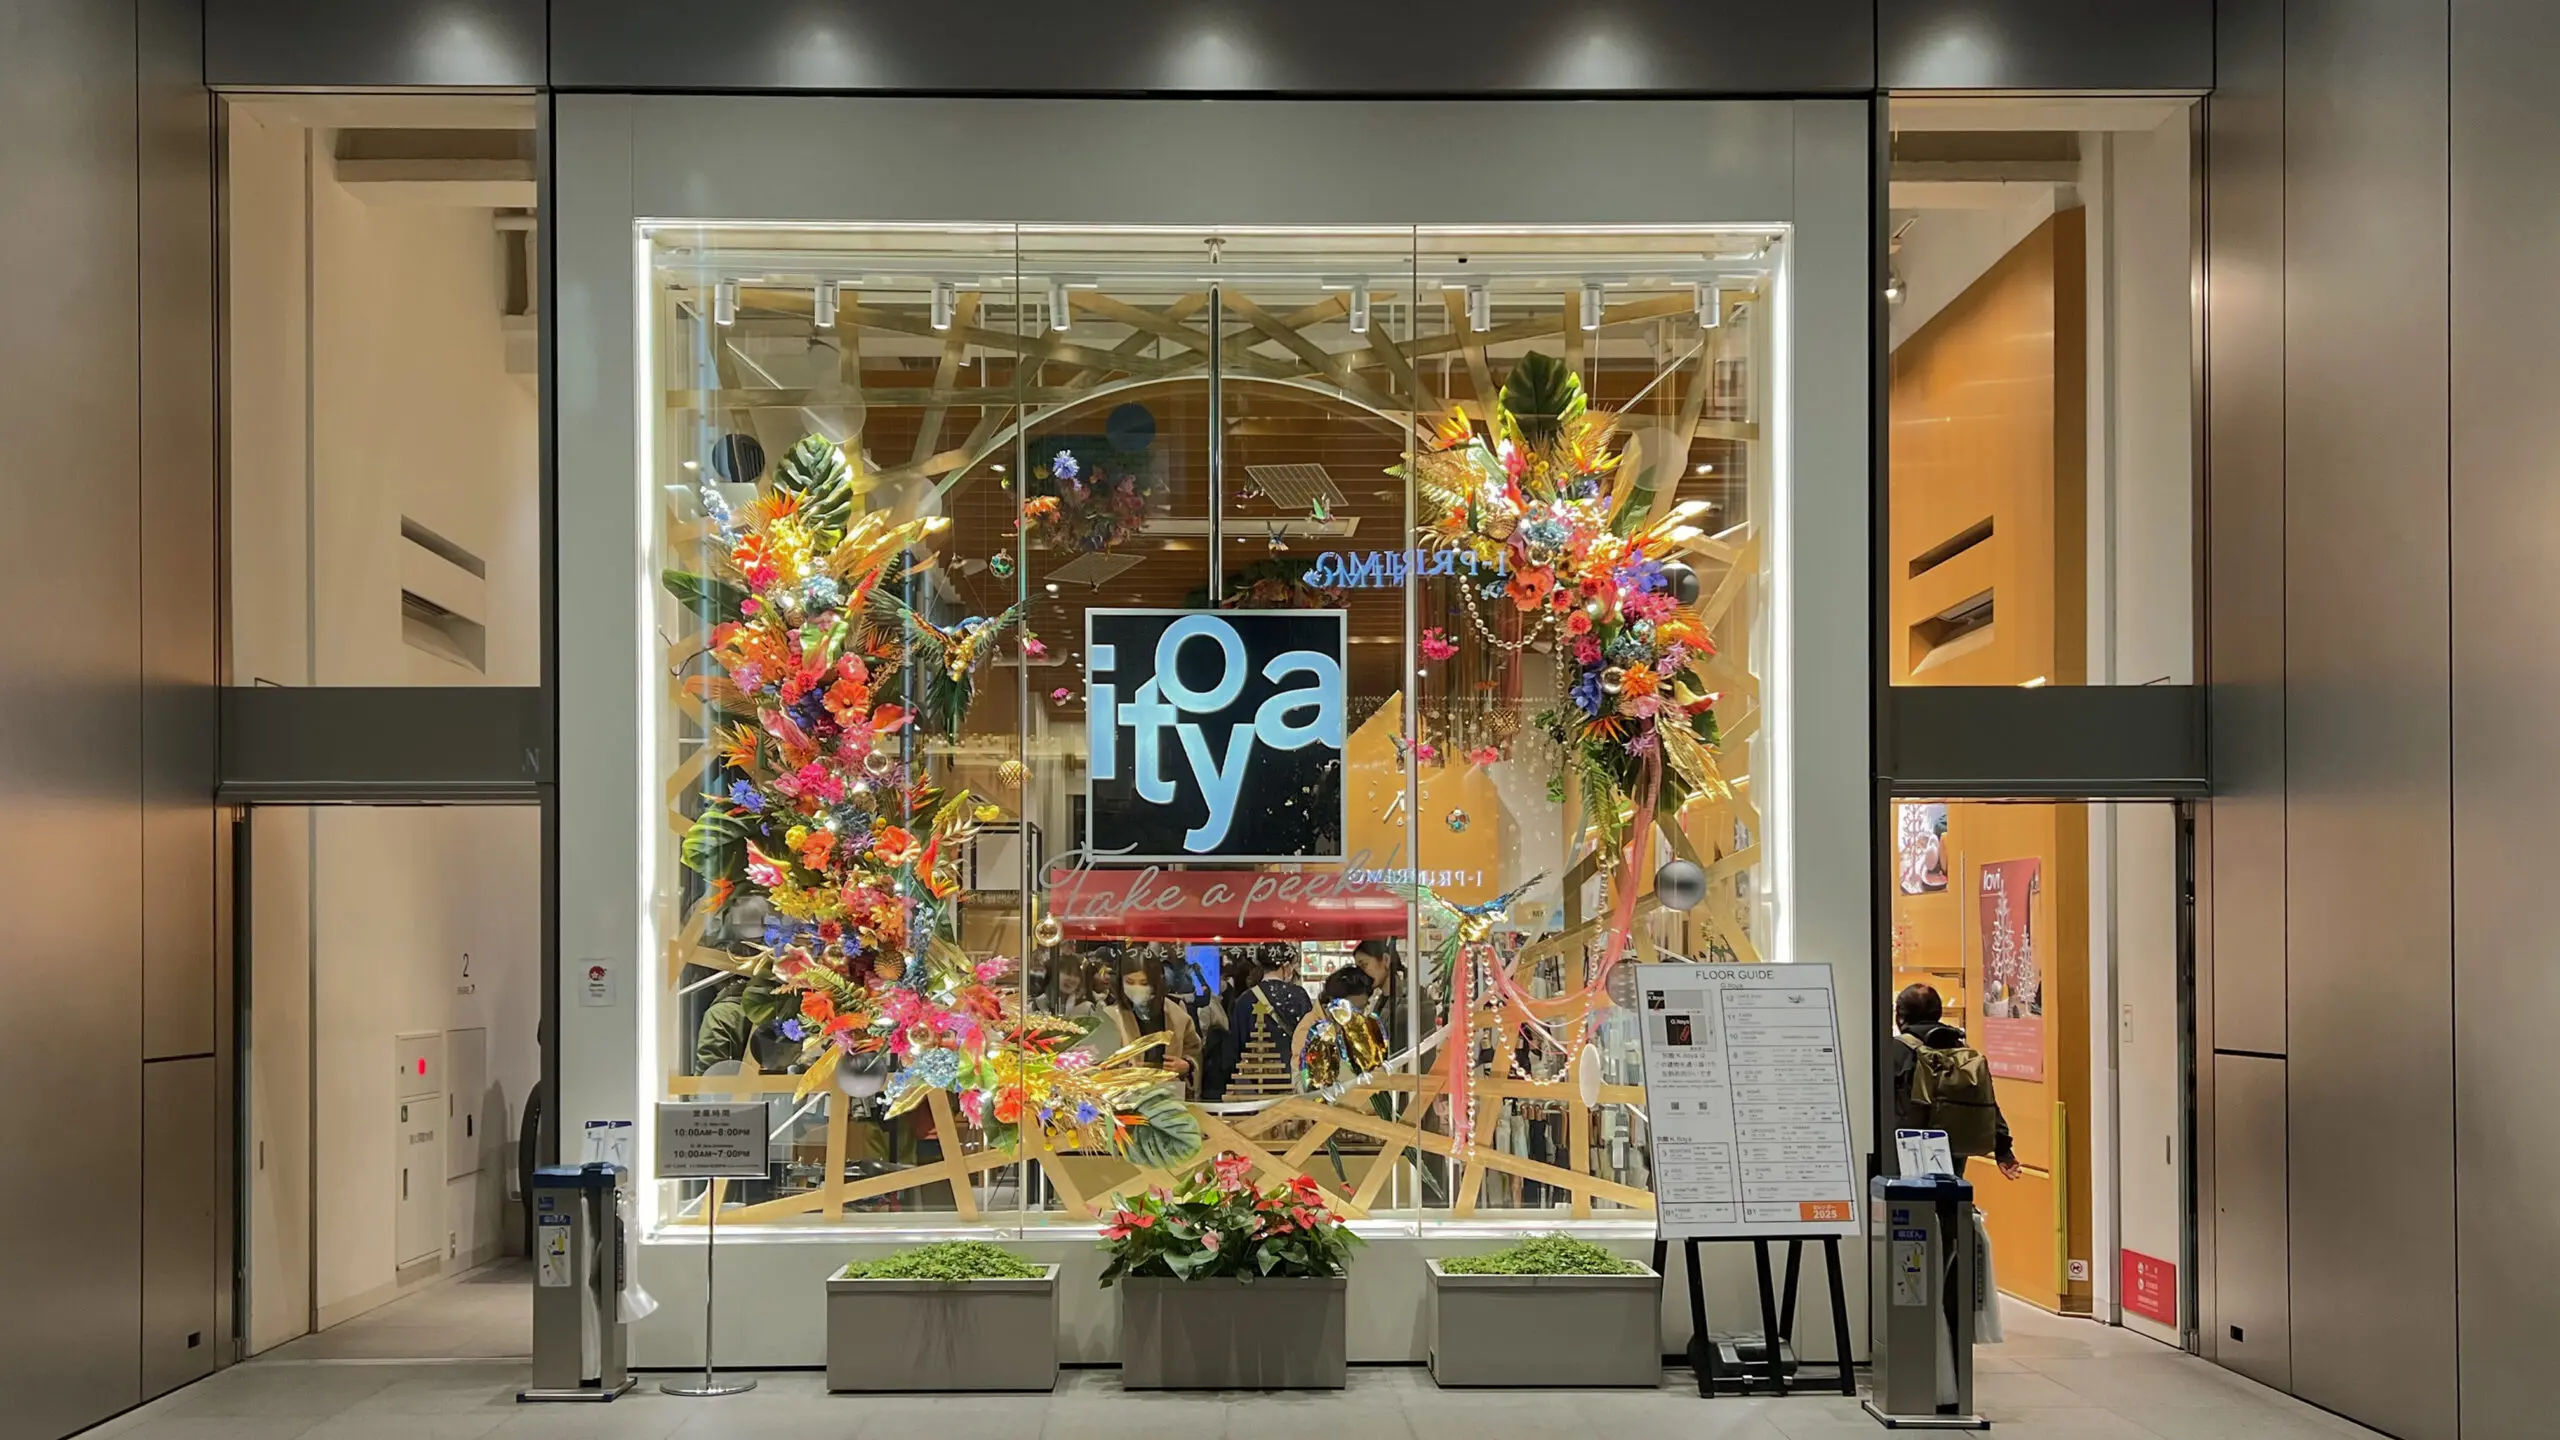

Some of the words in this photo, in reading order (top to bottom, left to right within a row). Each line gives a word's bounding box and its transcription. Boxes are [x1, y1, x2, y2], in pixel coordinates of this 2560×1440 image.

[1091, 614, 1341, 854] itoya
[1038, 840, 1186, 921] Take
[1201, 884, 1235, 908] a
[1983, 867, 2001, 891] lovi
[463, 952, 470, 978] 2
[1695, 970, 1736, 980] FLOOR
[1738, 970, 1775, 980] GUIDE
[1813, 1210, 1838, 1219] 2025
